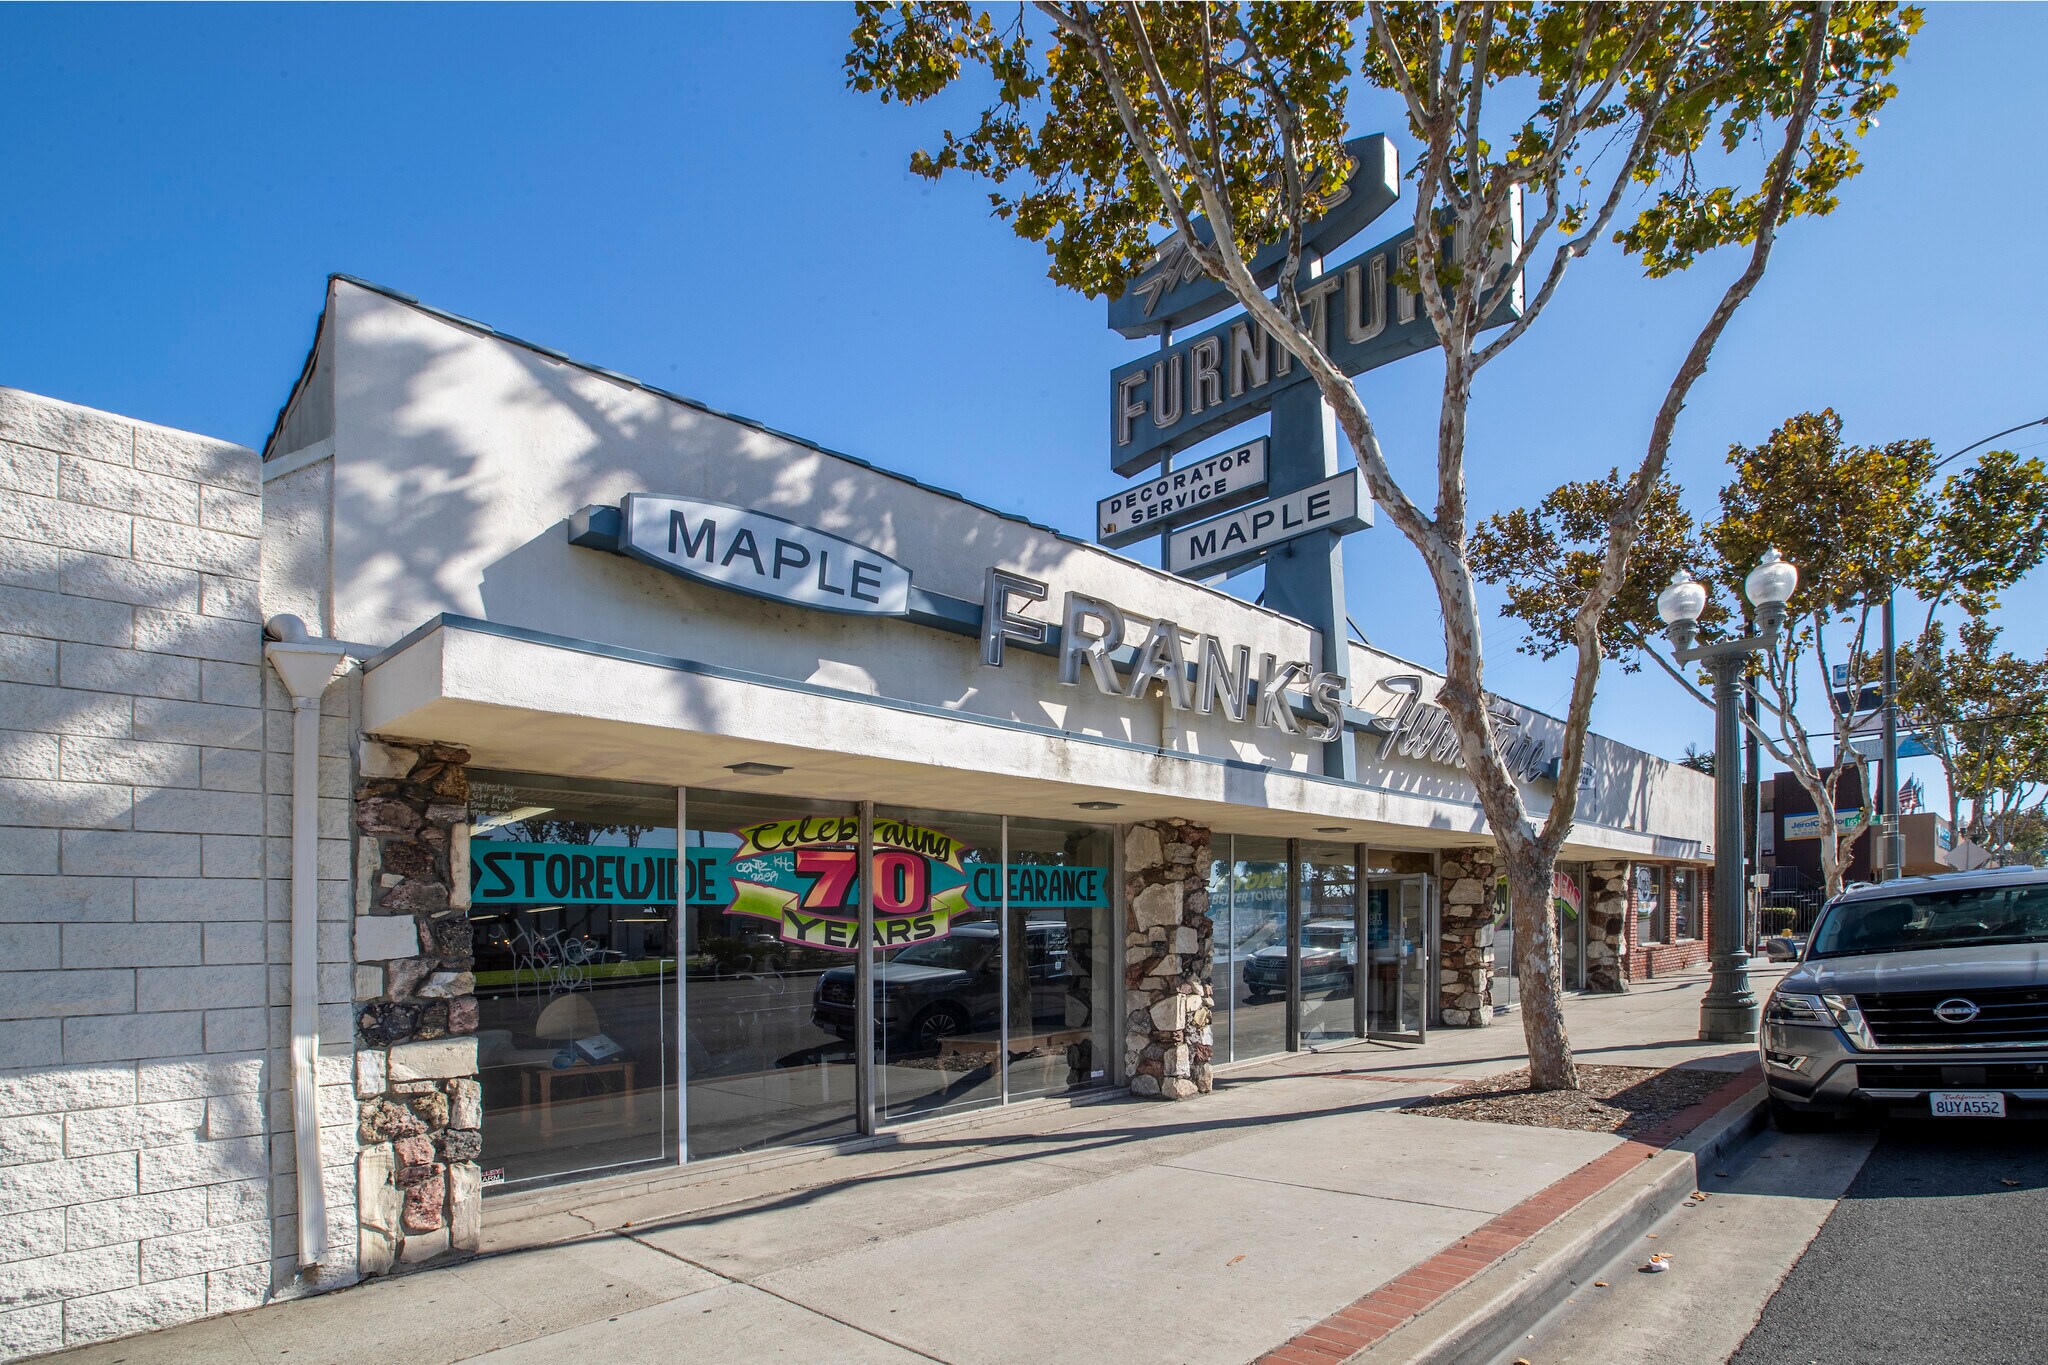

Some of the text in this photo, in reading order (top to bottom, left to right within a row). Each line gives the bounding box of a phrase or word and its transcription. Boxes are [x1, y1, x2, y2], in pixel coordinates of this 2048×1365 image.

[1117, 214, 1500, 446] FURNITU
[1111, 449, 1250, 514] DECORATOR
[1131, 479, 1226, 523] SERVICE
[1190, 490, 1330, 560] MAPLE
[668, 509, 884, 605] MAPLE
[980, 567, 1348, 743] FRANKS
[483, 852, 717, 901] STOREWIDE
[795, 847, 931, 917] 70
[973, 867, 1098, 902] CLEARANCE
[784, 908, 936, 948] YEARS
[1933, 1007, 1980, 1015] NISSAN
[1936, 1101, 2000, 1114] 8UYA552
